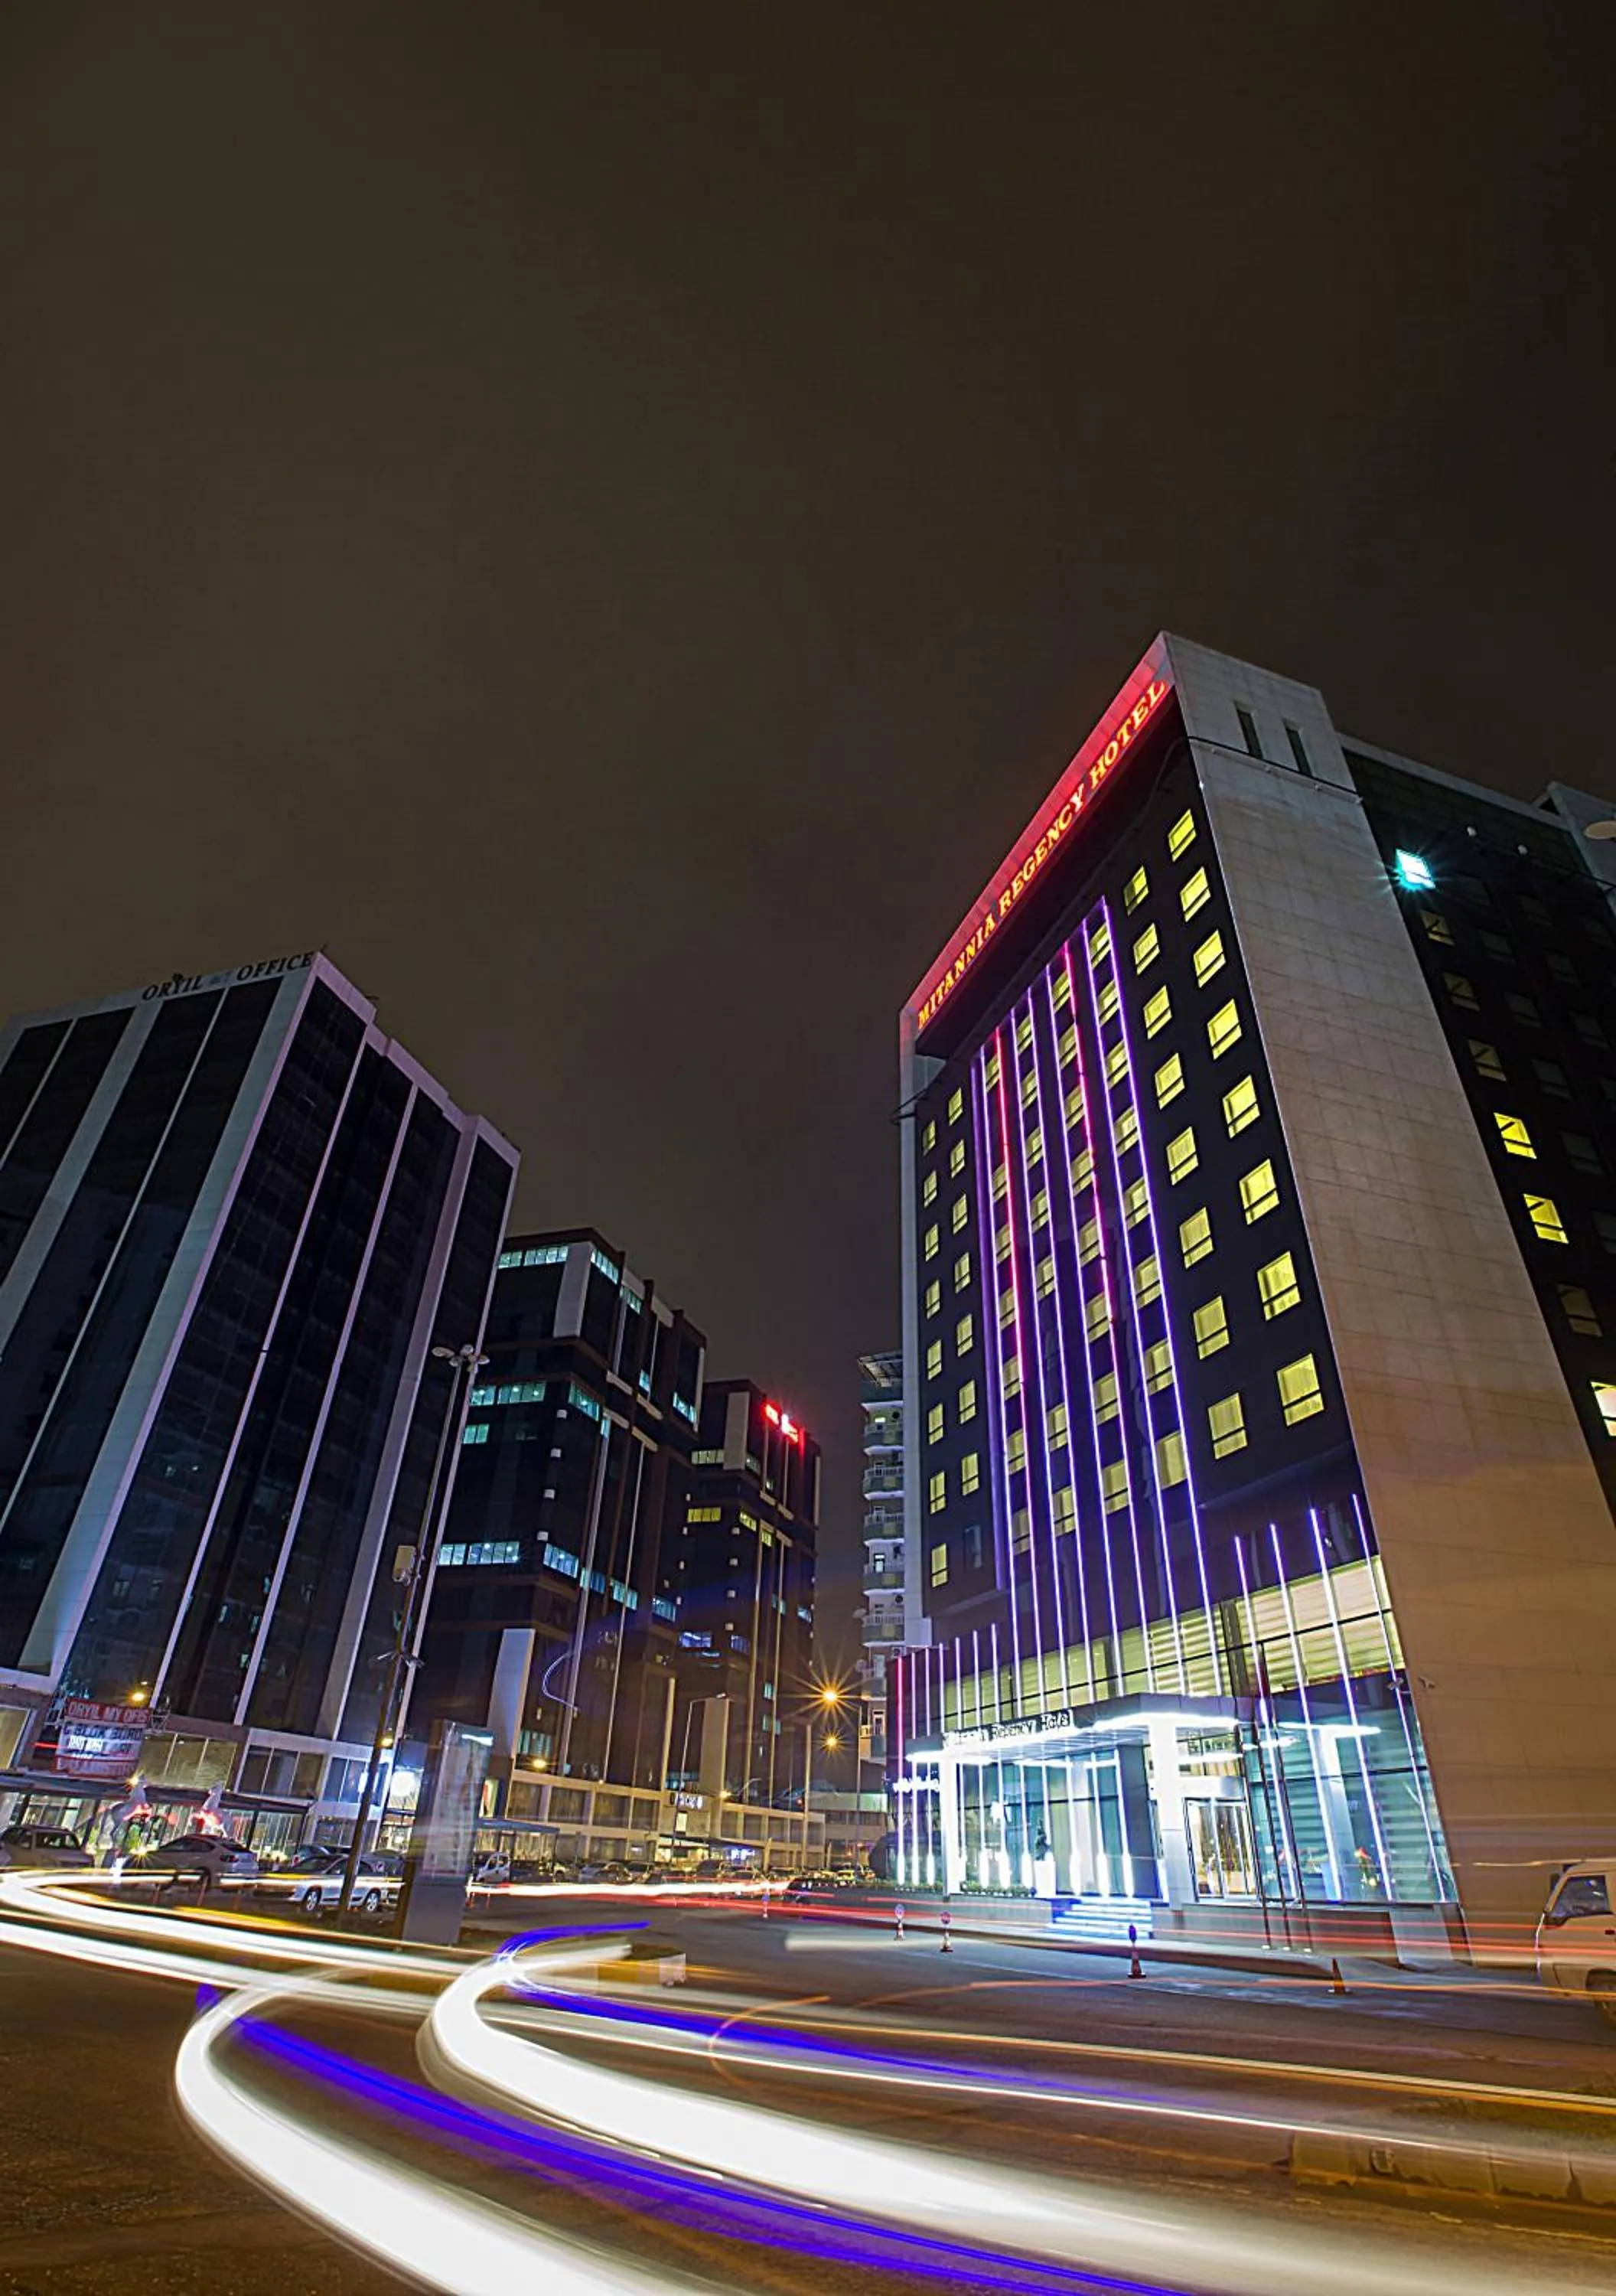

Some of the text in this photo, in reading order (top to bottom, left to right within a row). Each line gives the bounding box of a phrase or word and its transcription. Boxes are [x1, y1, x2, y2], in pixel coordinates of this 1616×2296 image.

[918, 680, 1166, 1030] MITANNIA REGENCY HOTEL
[236, 951, 314, 981] OFFICE
